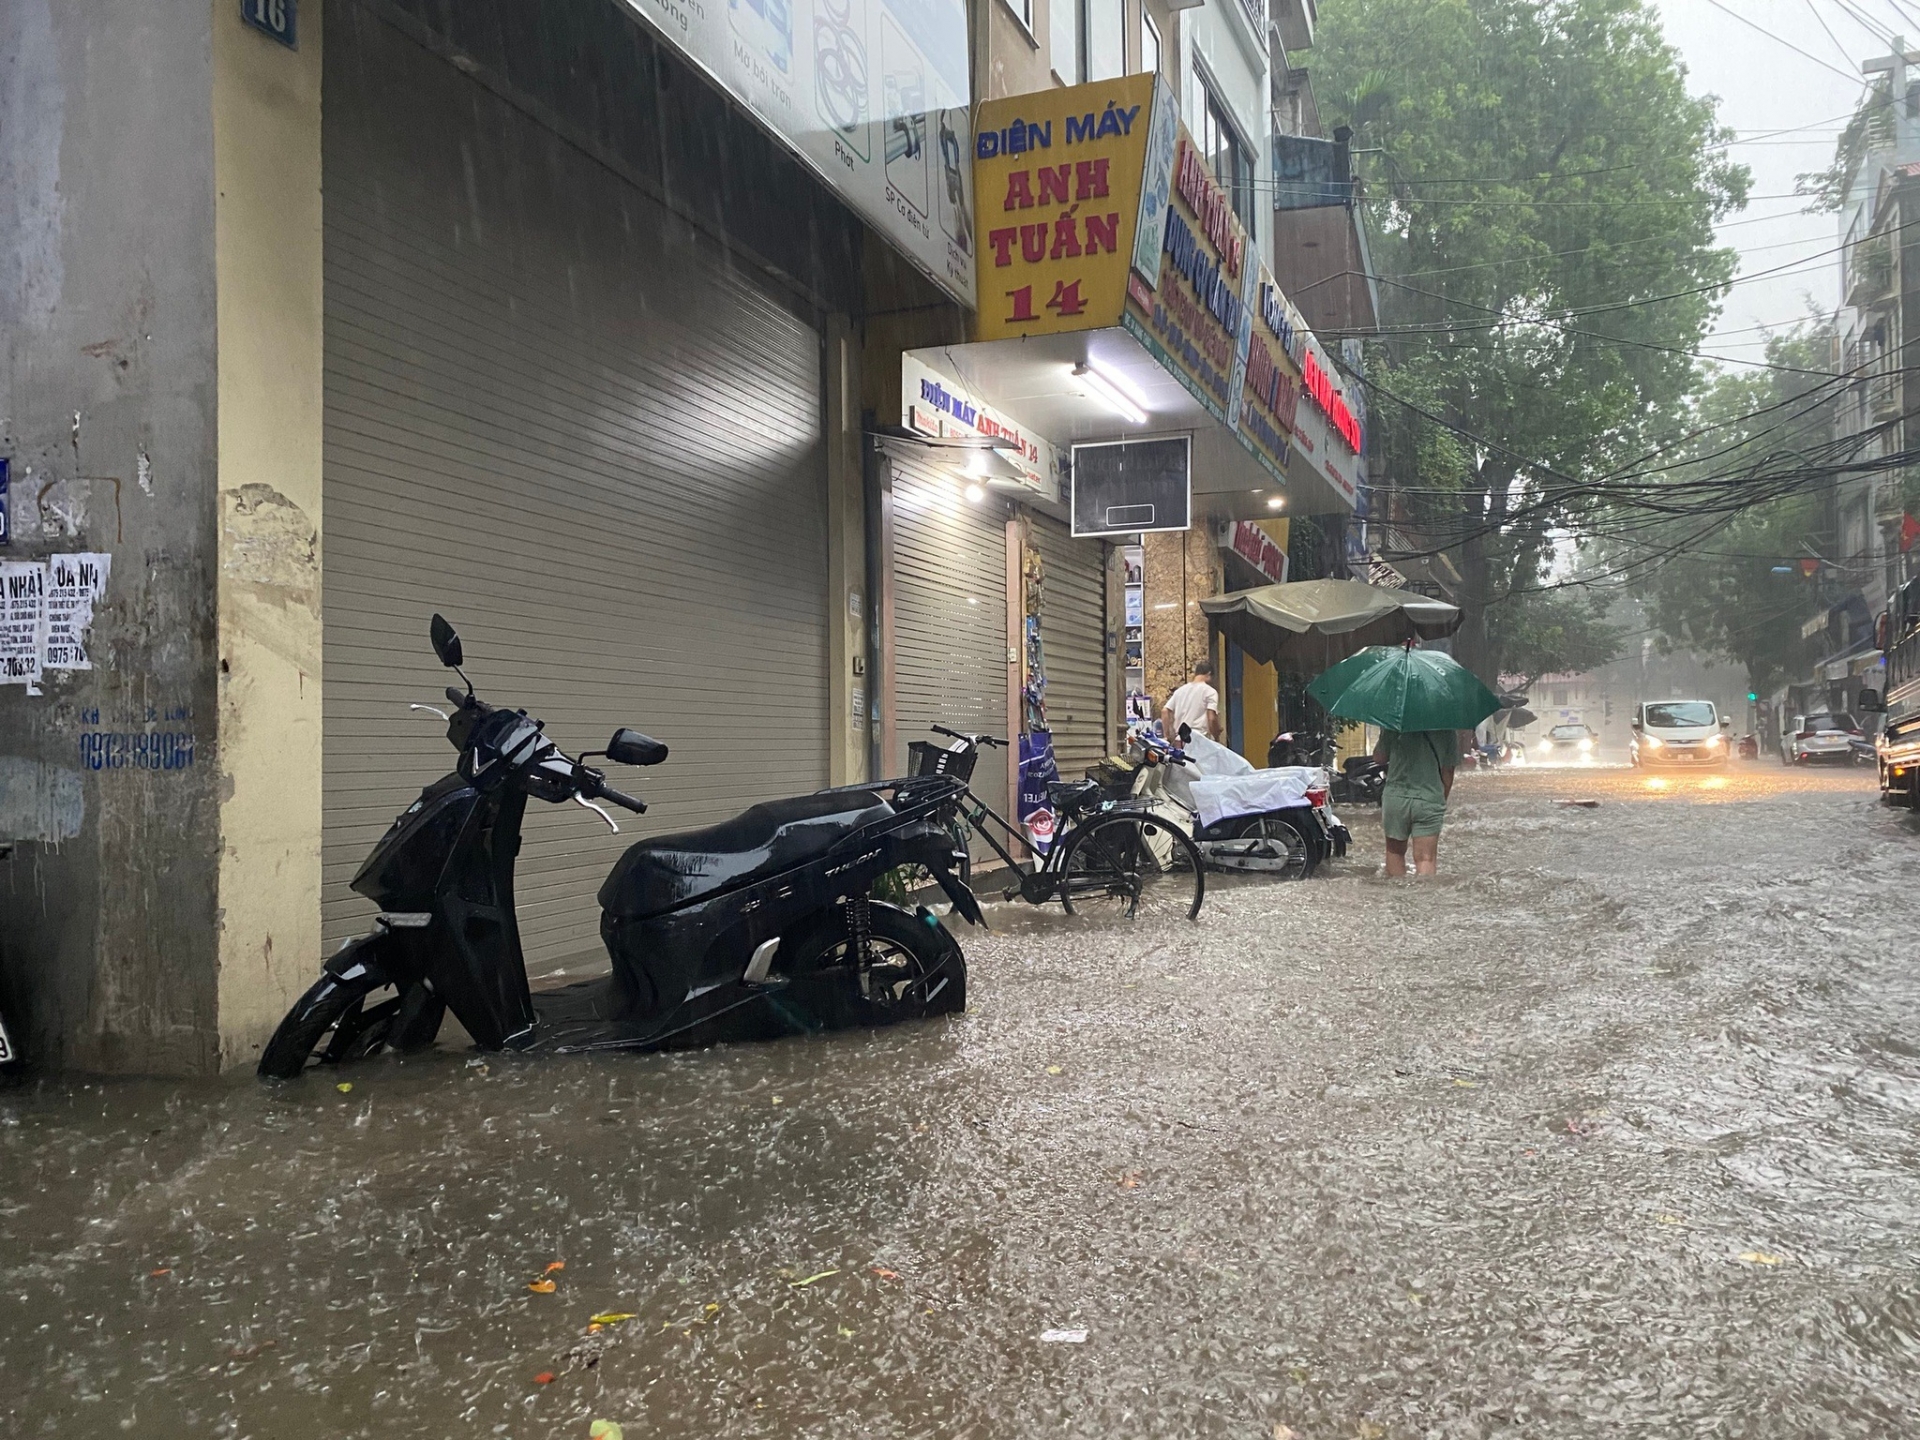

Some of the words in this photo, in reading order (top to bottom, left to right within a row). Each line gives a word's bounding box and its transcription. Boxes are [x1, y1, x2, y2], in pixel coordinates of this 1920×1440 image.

[1065, 99, 1141, 145] MÁY
[885, 186, 896, 205] SP
[1003, 157, 1110, 212] ANH
[1176, 140, 1205, 221] ANH
[989, 203, 1120, 268] TUẤN
[1004, 278, 1089, 323] 14
[920, 378, 951, 412] ĐIỆN
[952, 398, 977, 427] MÁY
[976, 413, 1001, 438] ANH
[1029, 443, 1038, 464] 14
[47, 646, 69, 664] 0975
